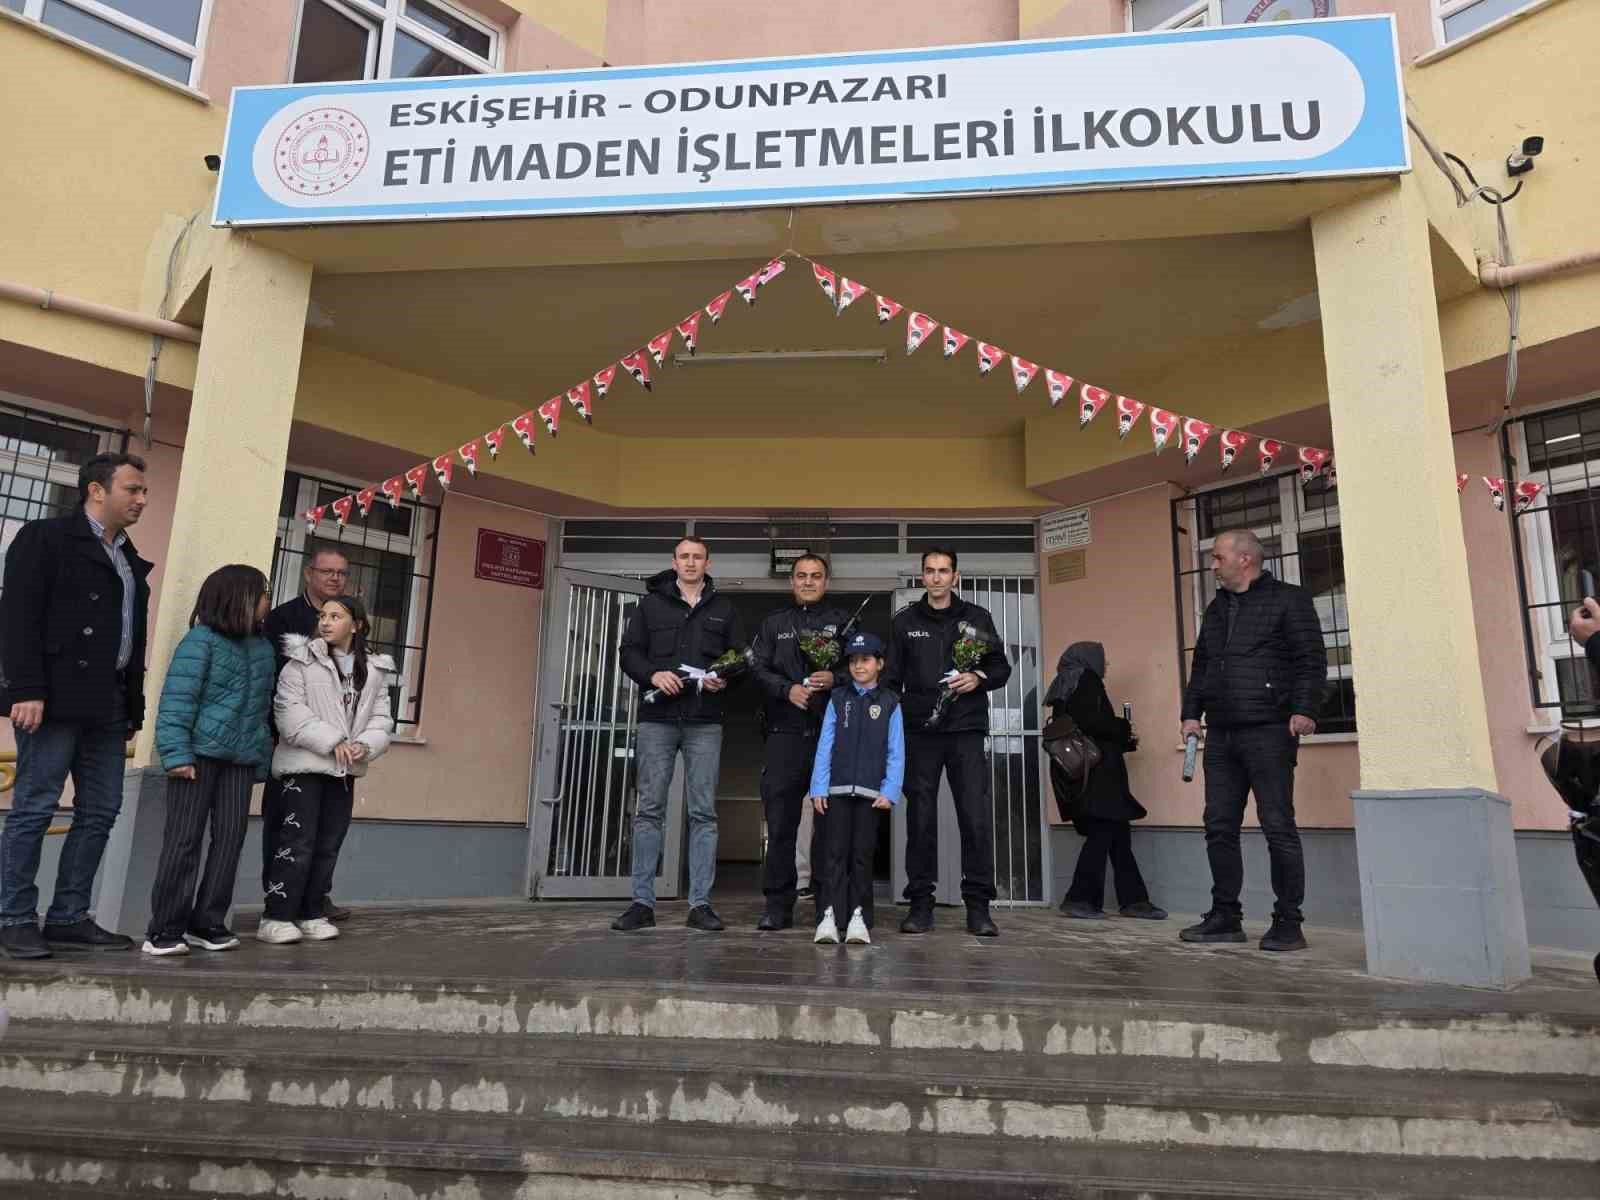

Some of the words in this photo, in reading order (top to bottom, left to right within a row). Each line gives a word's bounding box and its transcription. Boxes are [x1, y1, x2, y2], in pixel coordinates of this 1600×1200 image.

[389, 90, 606, 128] ESKİŞEHİR
[645, 73, 946, 114] ODUNPAZARI
[383, 138, 456, 187] ETİ
[469, 137, 661, 183] MADEN
[677, 106, 1013, 183] İŞLETMELERİ
[1033, 101, 1321, 154] İLKOKULU
